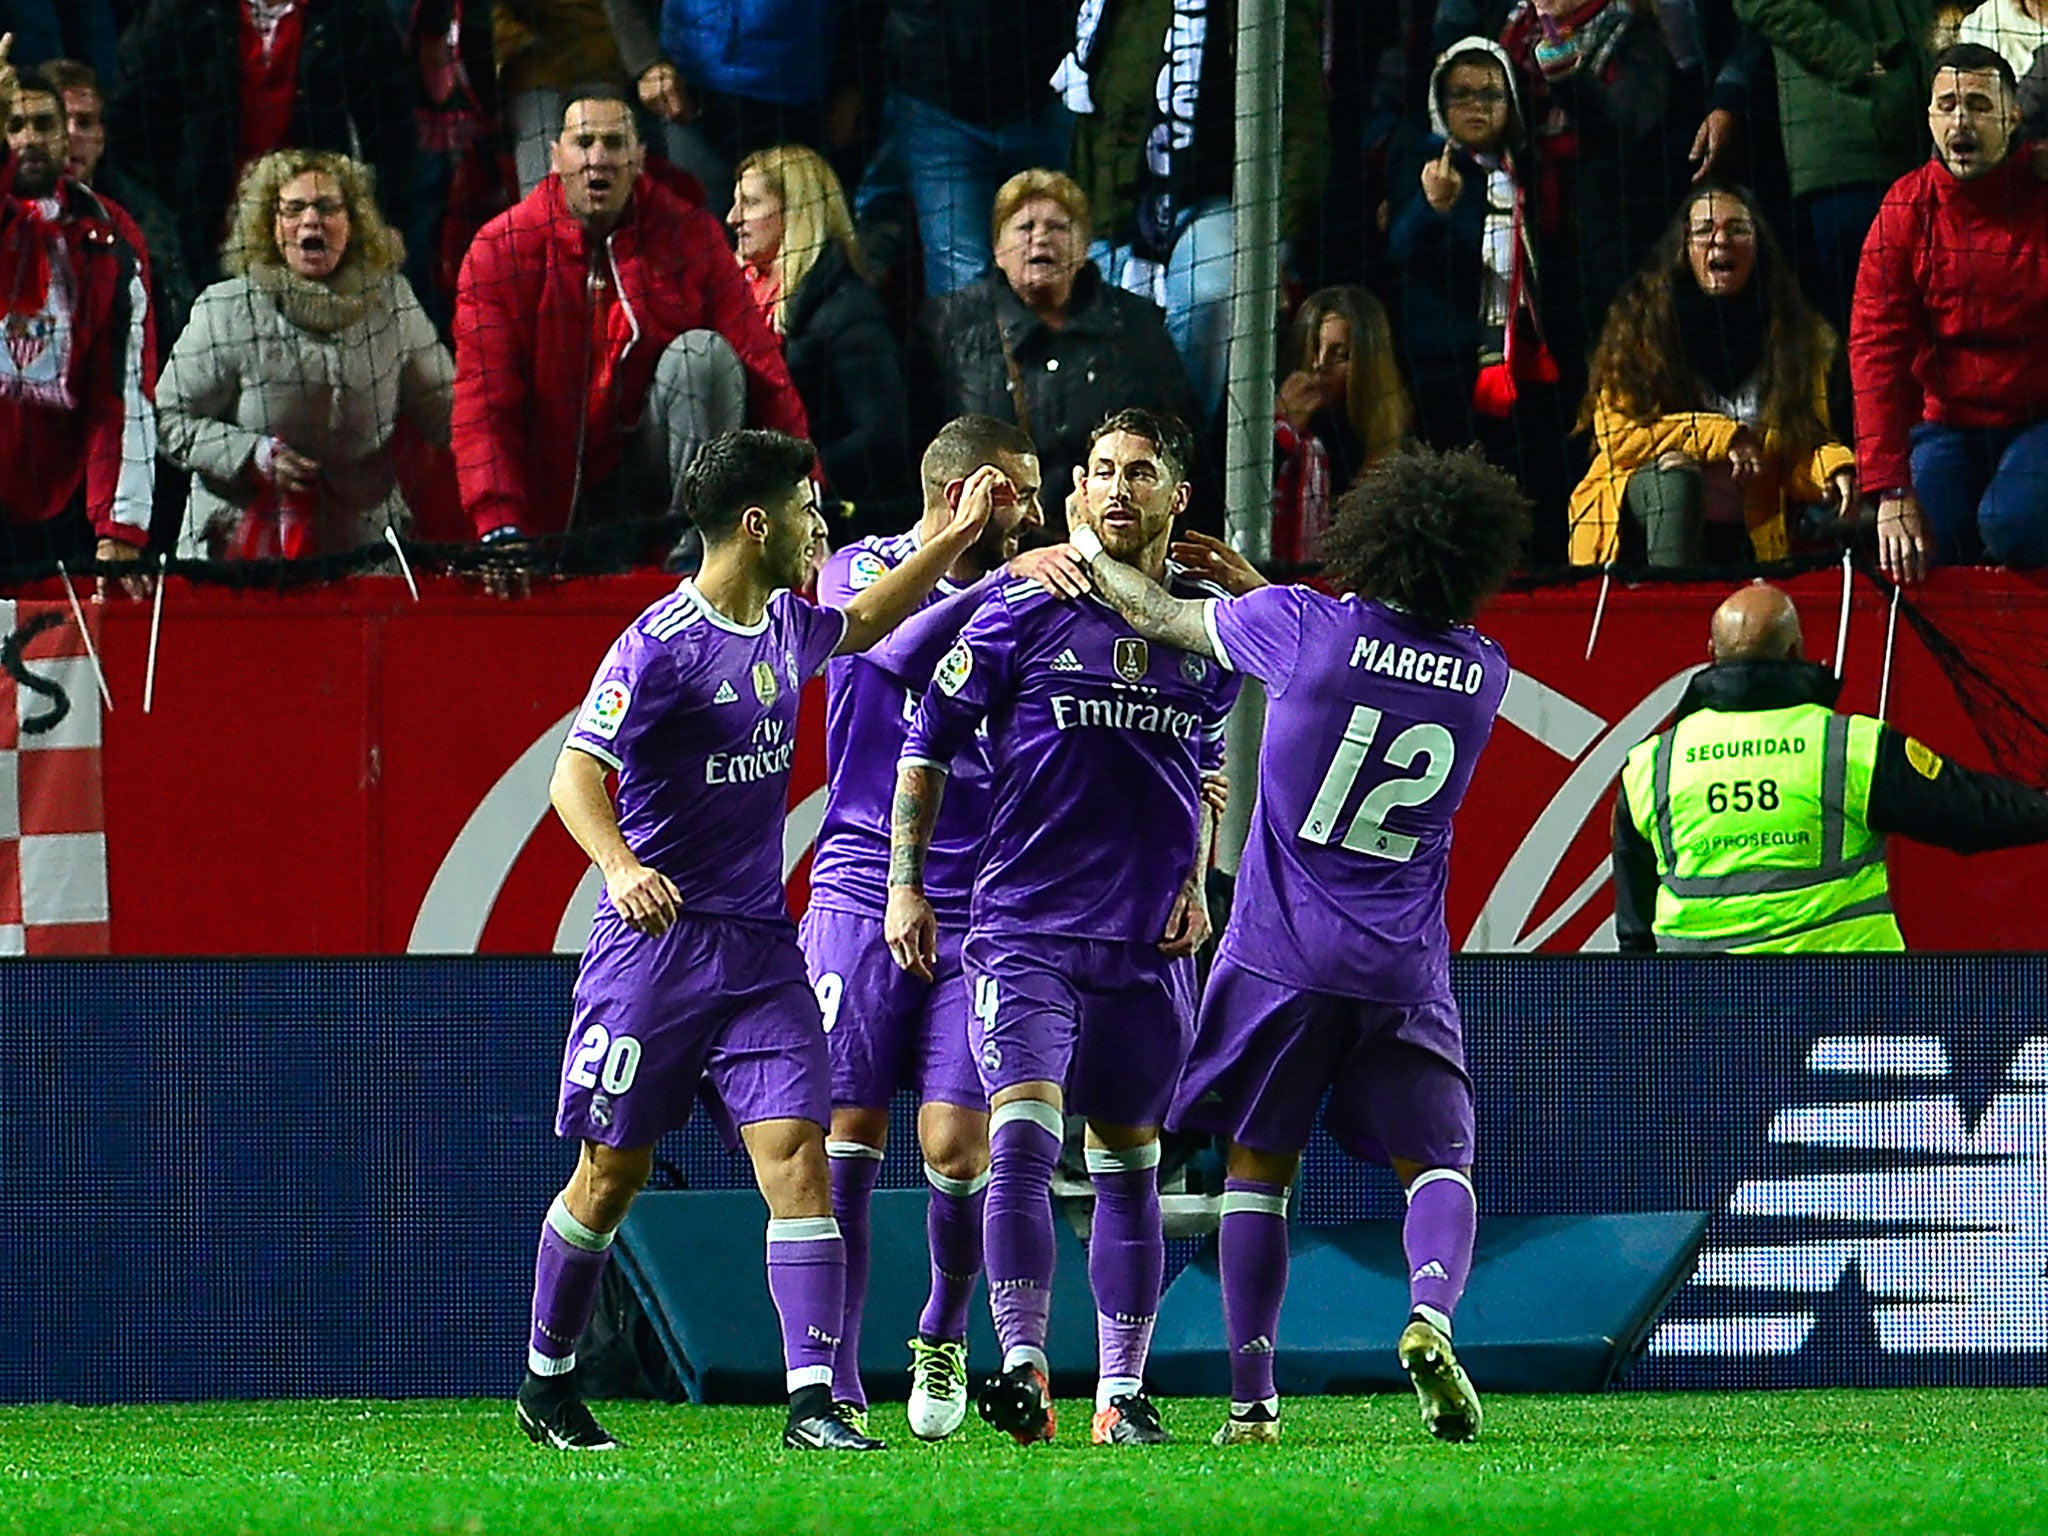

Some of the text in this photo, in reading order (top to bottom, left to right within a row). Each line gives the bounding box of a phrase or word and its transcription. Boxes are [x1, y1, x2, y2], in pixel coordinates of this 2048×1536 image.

[1349, 636, 1484, 695] MARCELO
[1686, 737, 1806, 763] SEGURIDAD
[1298, 704, 1455, 862] 12
[1707, 778, 1780, 814] 658
[815, 971, 844, 1034] 9
[975, 975, 999, 1033] 4
[567, 1023, 642, 1095] 20
